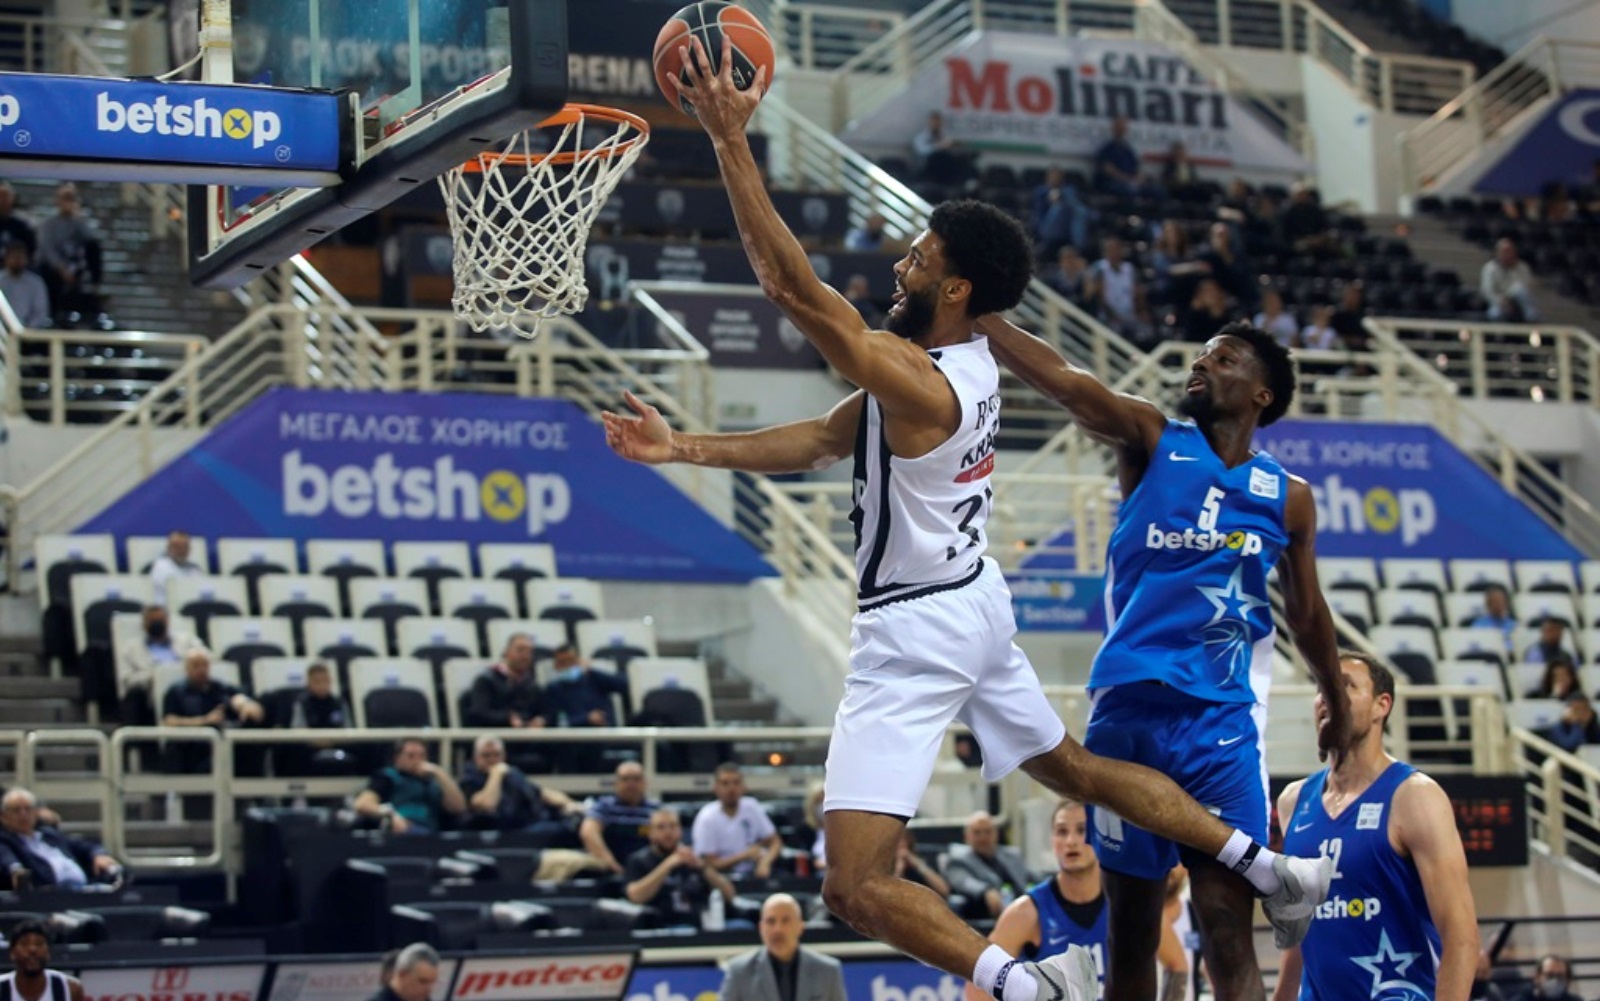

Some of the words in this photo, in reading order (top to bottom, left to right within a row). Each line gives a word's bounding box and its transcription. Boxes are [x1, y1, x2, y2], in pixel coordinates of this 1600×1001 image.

[943, 57, 1229, 130] Molinari
[97, 91, 281, 149] betshop
[282, 448, 571, 537] betshop
[1197, 486, 1226, 531] 5
[1146, 523, 1262, 557] betshop
[1313, 895, 1381, 921] tshop
[456, 963, 627, 997] mateco
